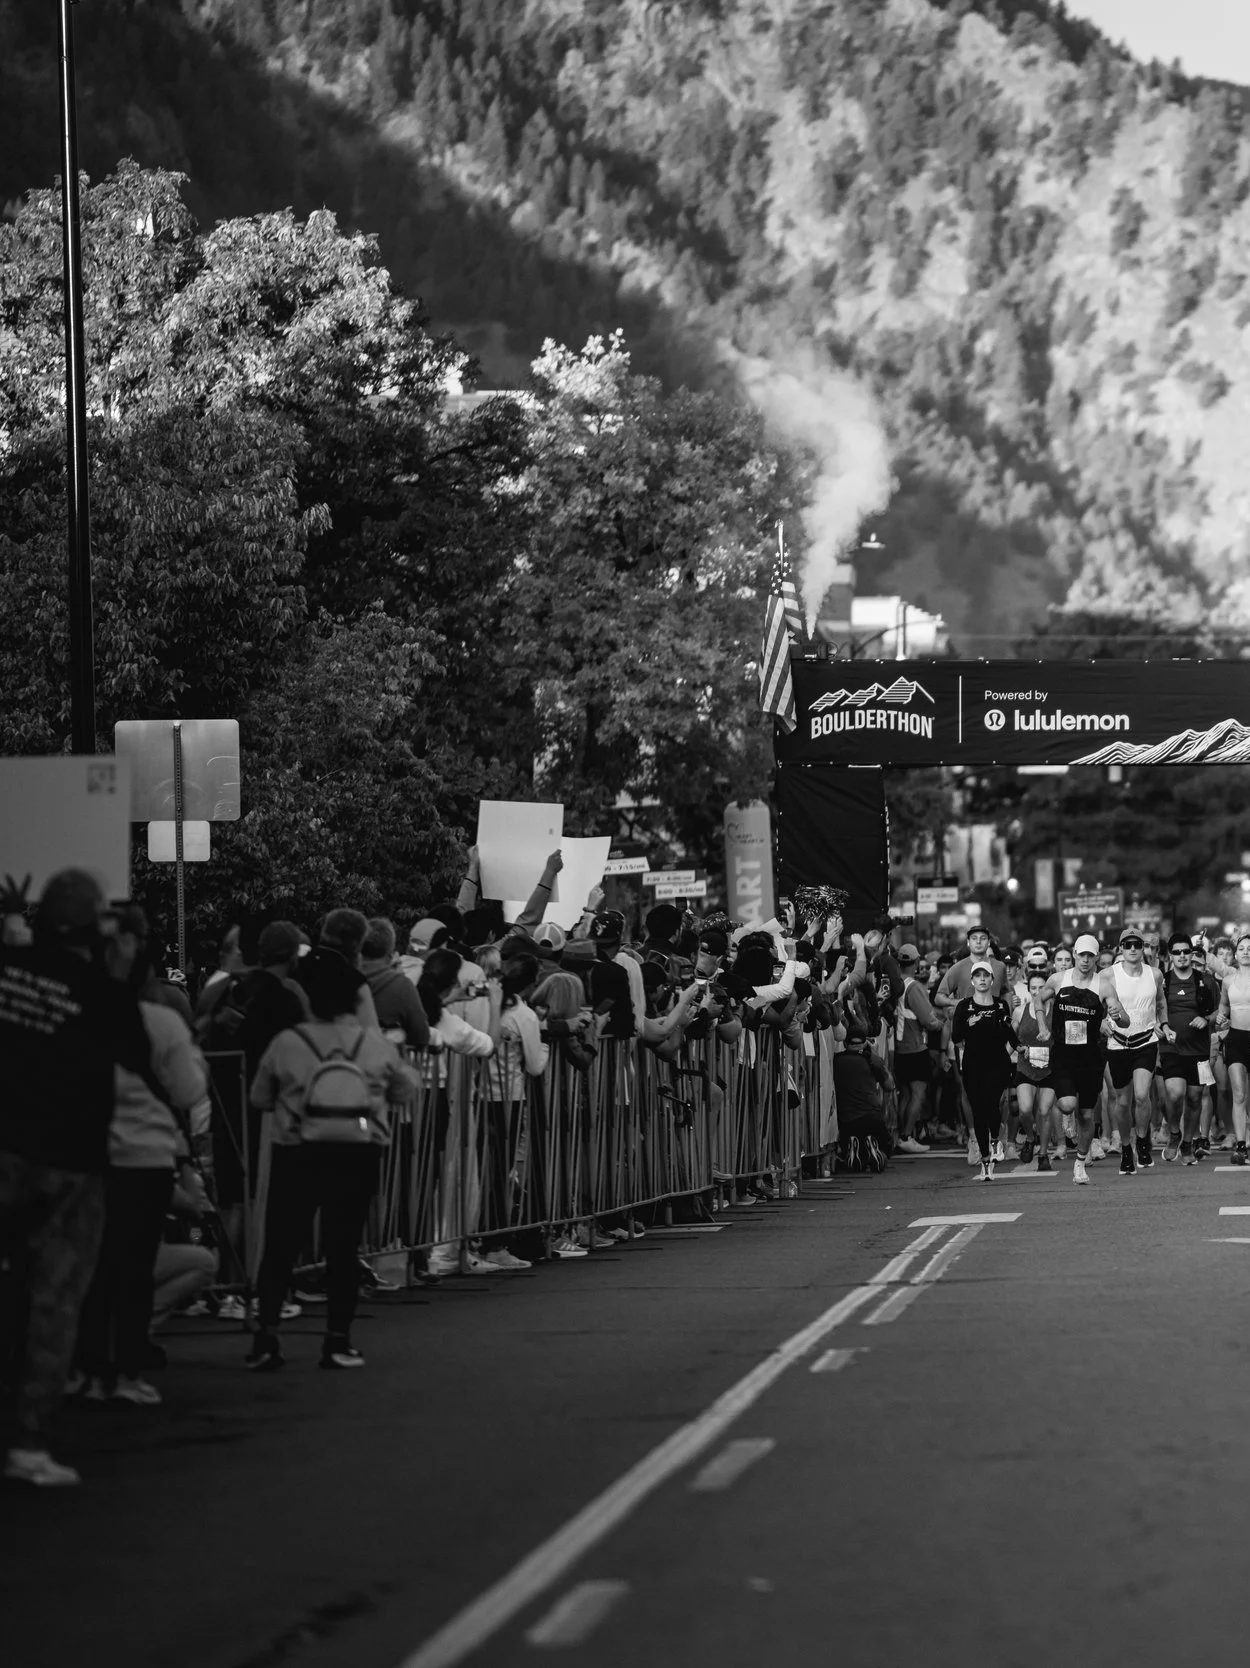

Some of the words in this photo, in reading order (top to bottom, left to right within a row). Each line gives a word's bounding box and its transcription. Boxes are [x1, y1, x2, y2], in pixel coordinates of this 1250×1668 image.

[984, 689, 1032, 701] Powered
[1034, 689, 1049, 702] by
[810, 708, 933, 740] BOULDERTHON
[1014, 709, 1130, 731] lululemon
[735, 855, 763, 921] ART
